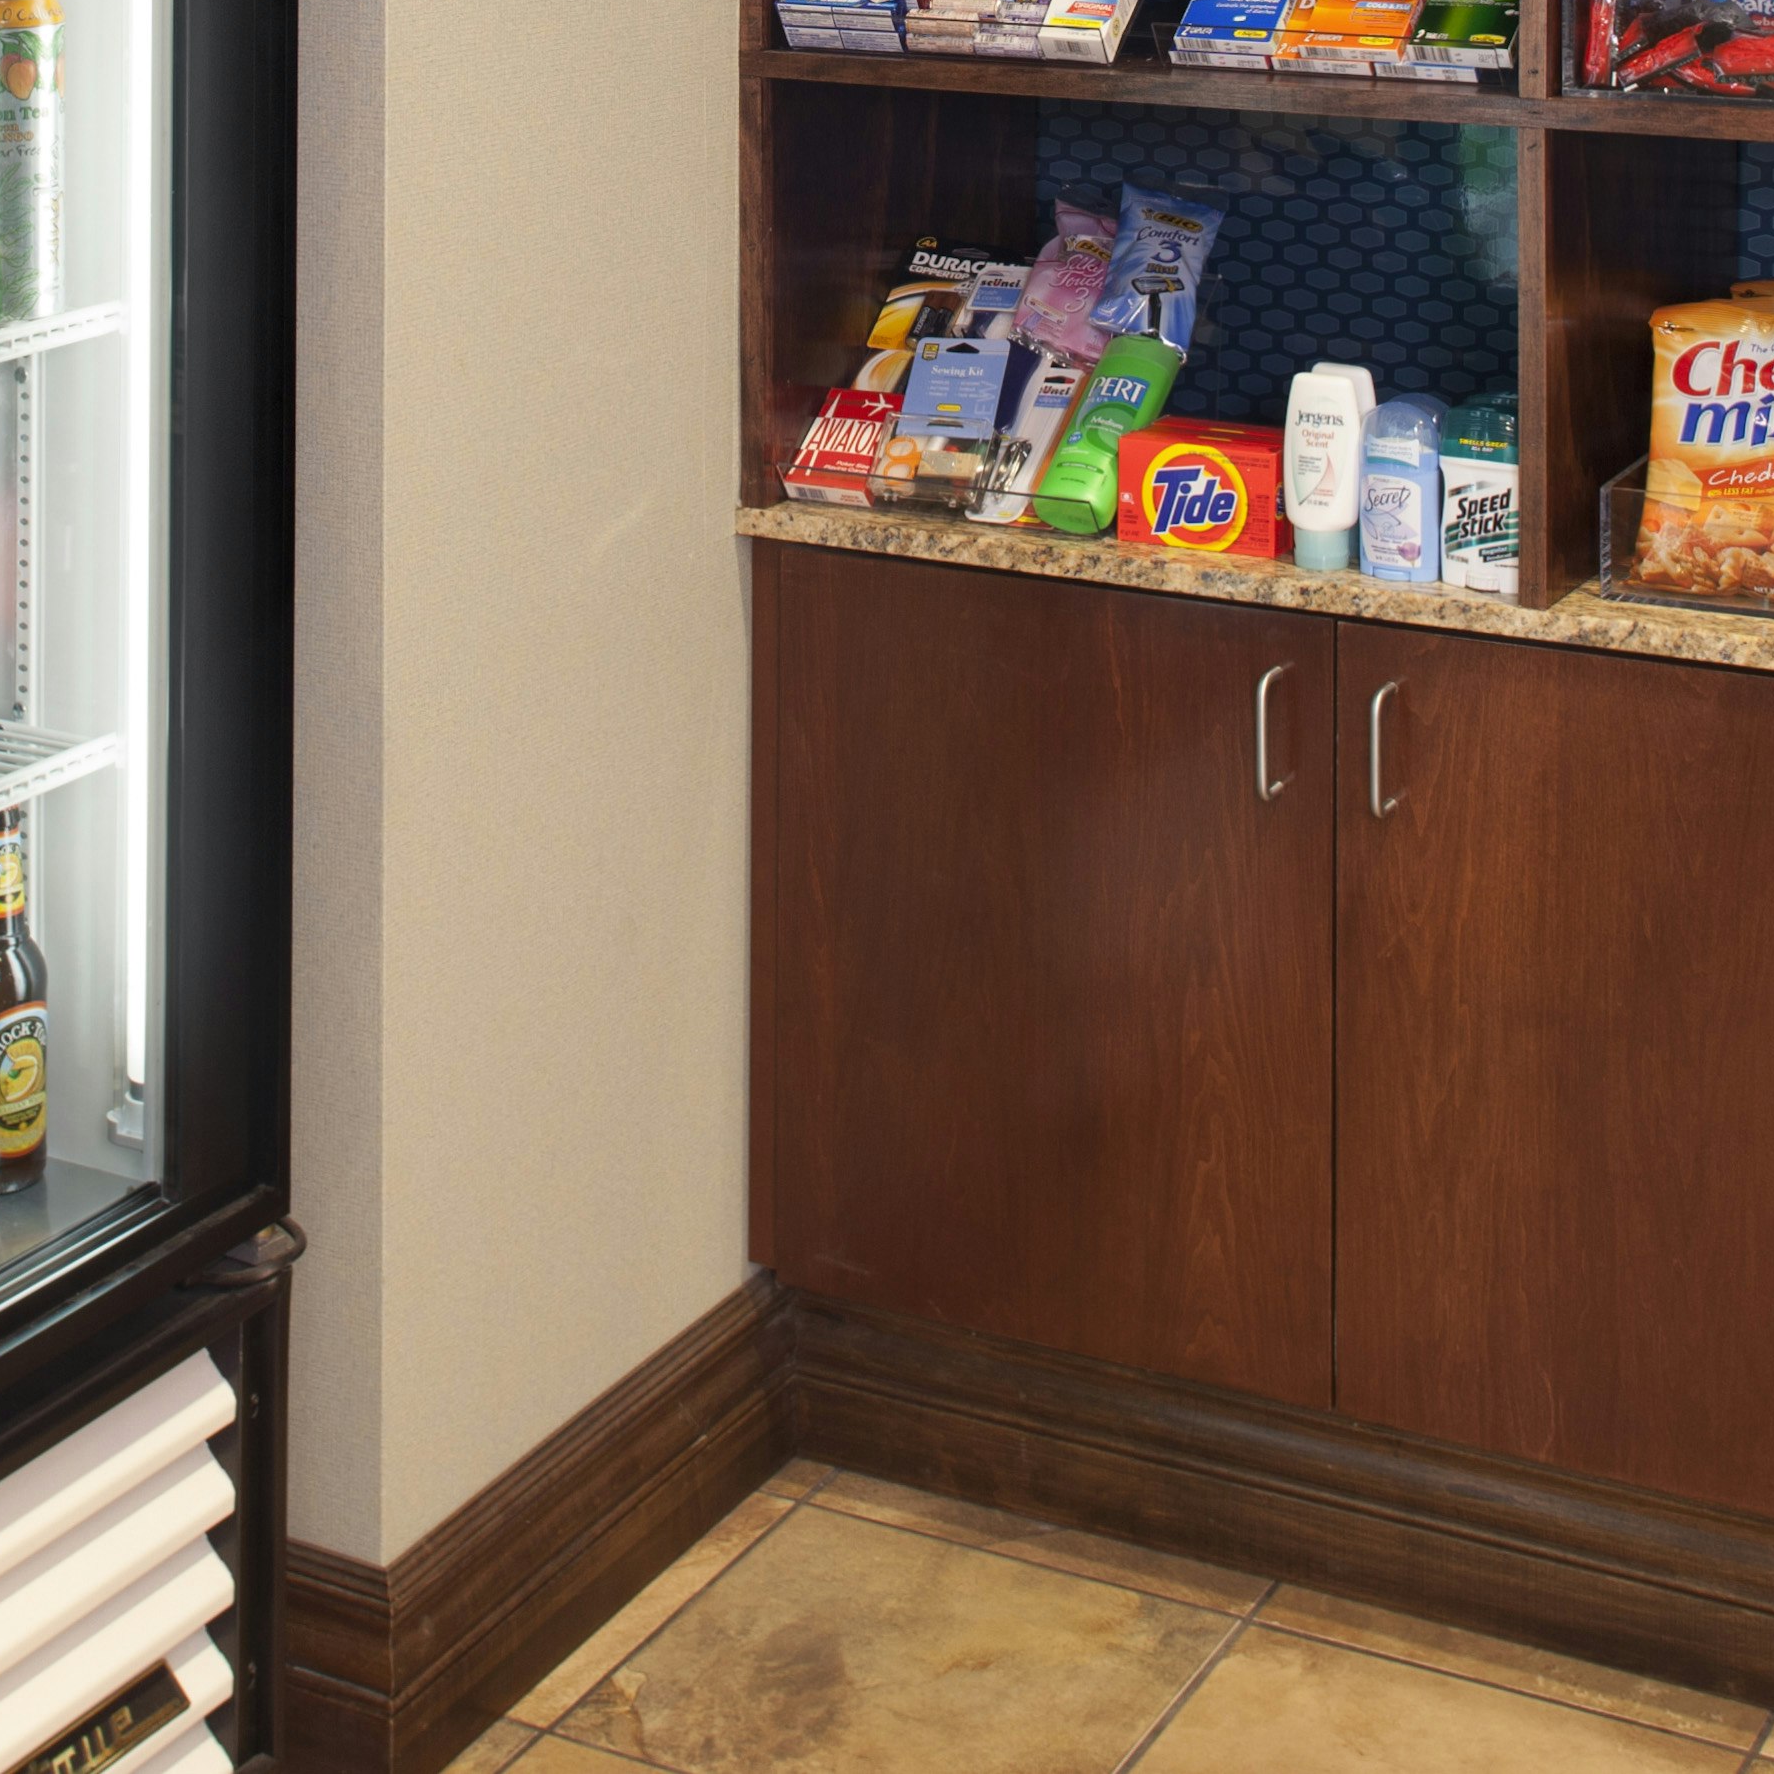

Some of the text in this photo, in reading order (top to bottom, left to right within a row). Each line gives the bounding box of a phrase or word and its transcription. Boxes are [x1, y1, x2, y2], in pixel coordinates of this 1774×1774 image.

[1136, 226, 1200, 247] Comfort
[1152, 241, 1182, 263] 3
[908, 264, 970, 280] COPPERTOP
[1750, 343, 1768, 353] The
[931, 365, 984, 378] Sewing Kit
[1088, 376, 1146, 403] PERT
[1295, 410, 1344, 428] Jergens
[1302, 429, 1335, 442] Original
[1306, 439, 1329, 449] Scent
[1151, 465, 1237, 534] Tide
[1366, 487, 1411, 512] Secret
[1456, 489, 1512, 520] Speed
